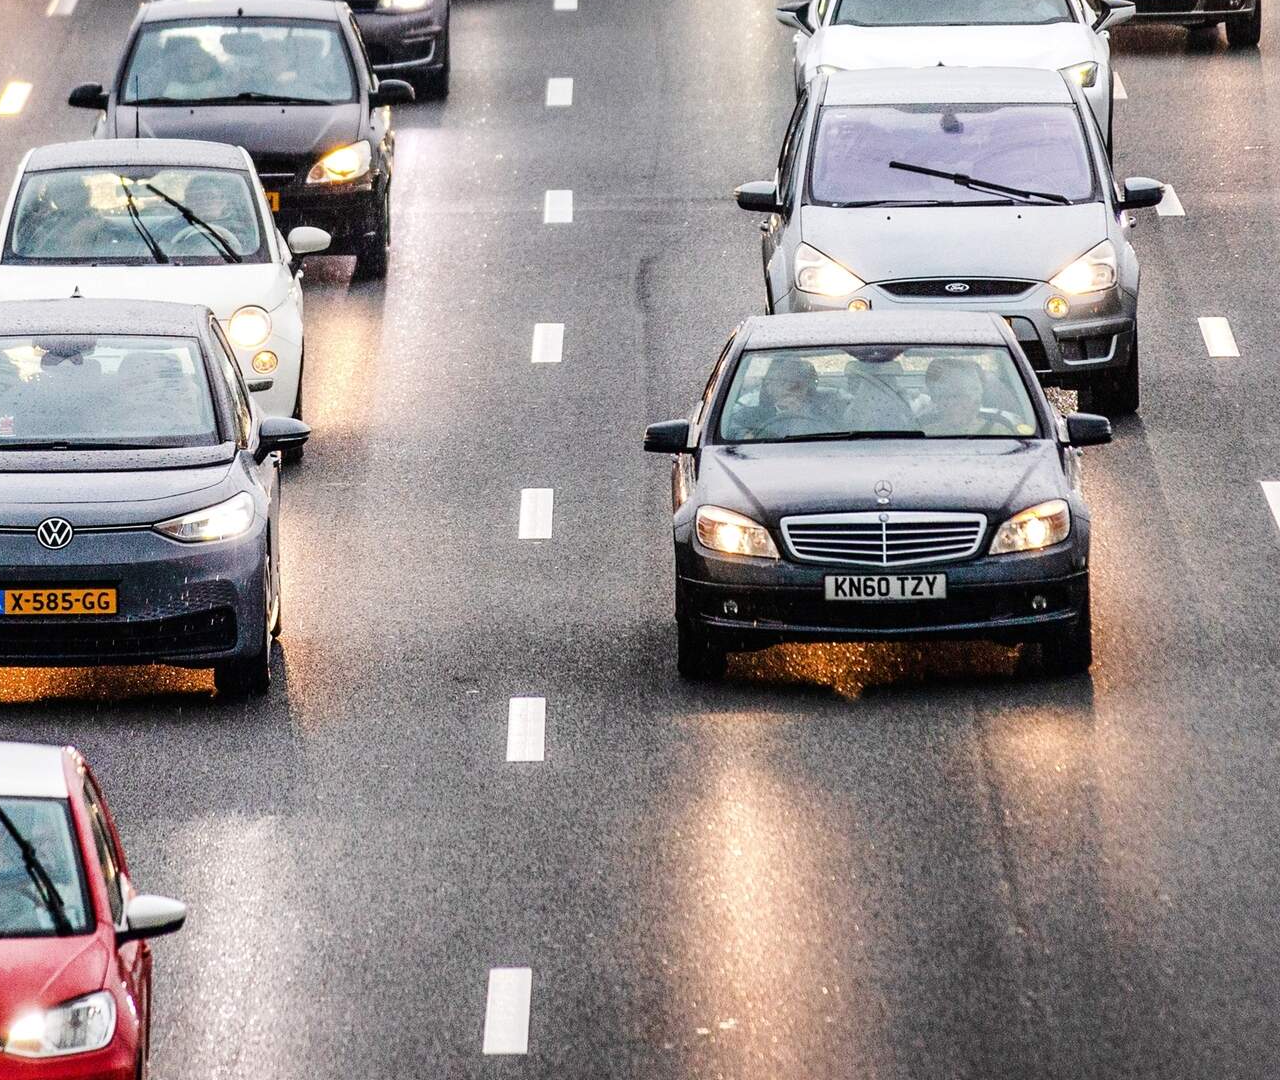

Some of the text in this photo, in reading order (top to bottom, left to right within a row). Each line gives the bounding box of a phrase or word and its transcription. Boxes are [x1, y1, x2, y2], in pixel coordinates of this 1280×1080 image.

[834, 575, 938, 599] KN60 TZY
[11, 591, 110, 612] X-585-GG
